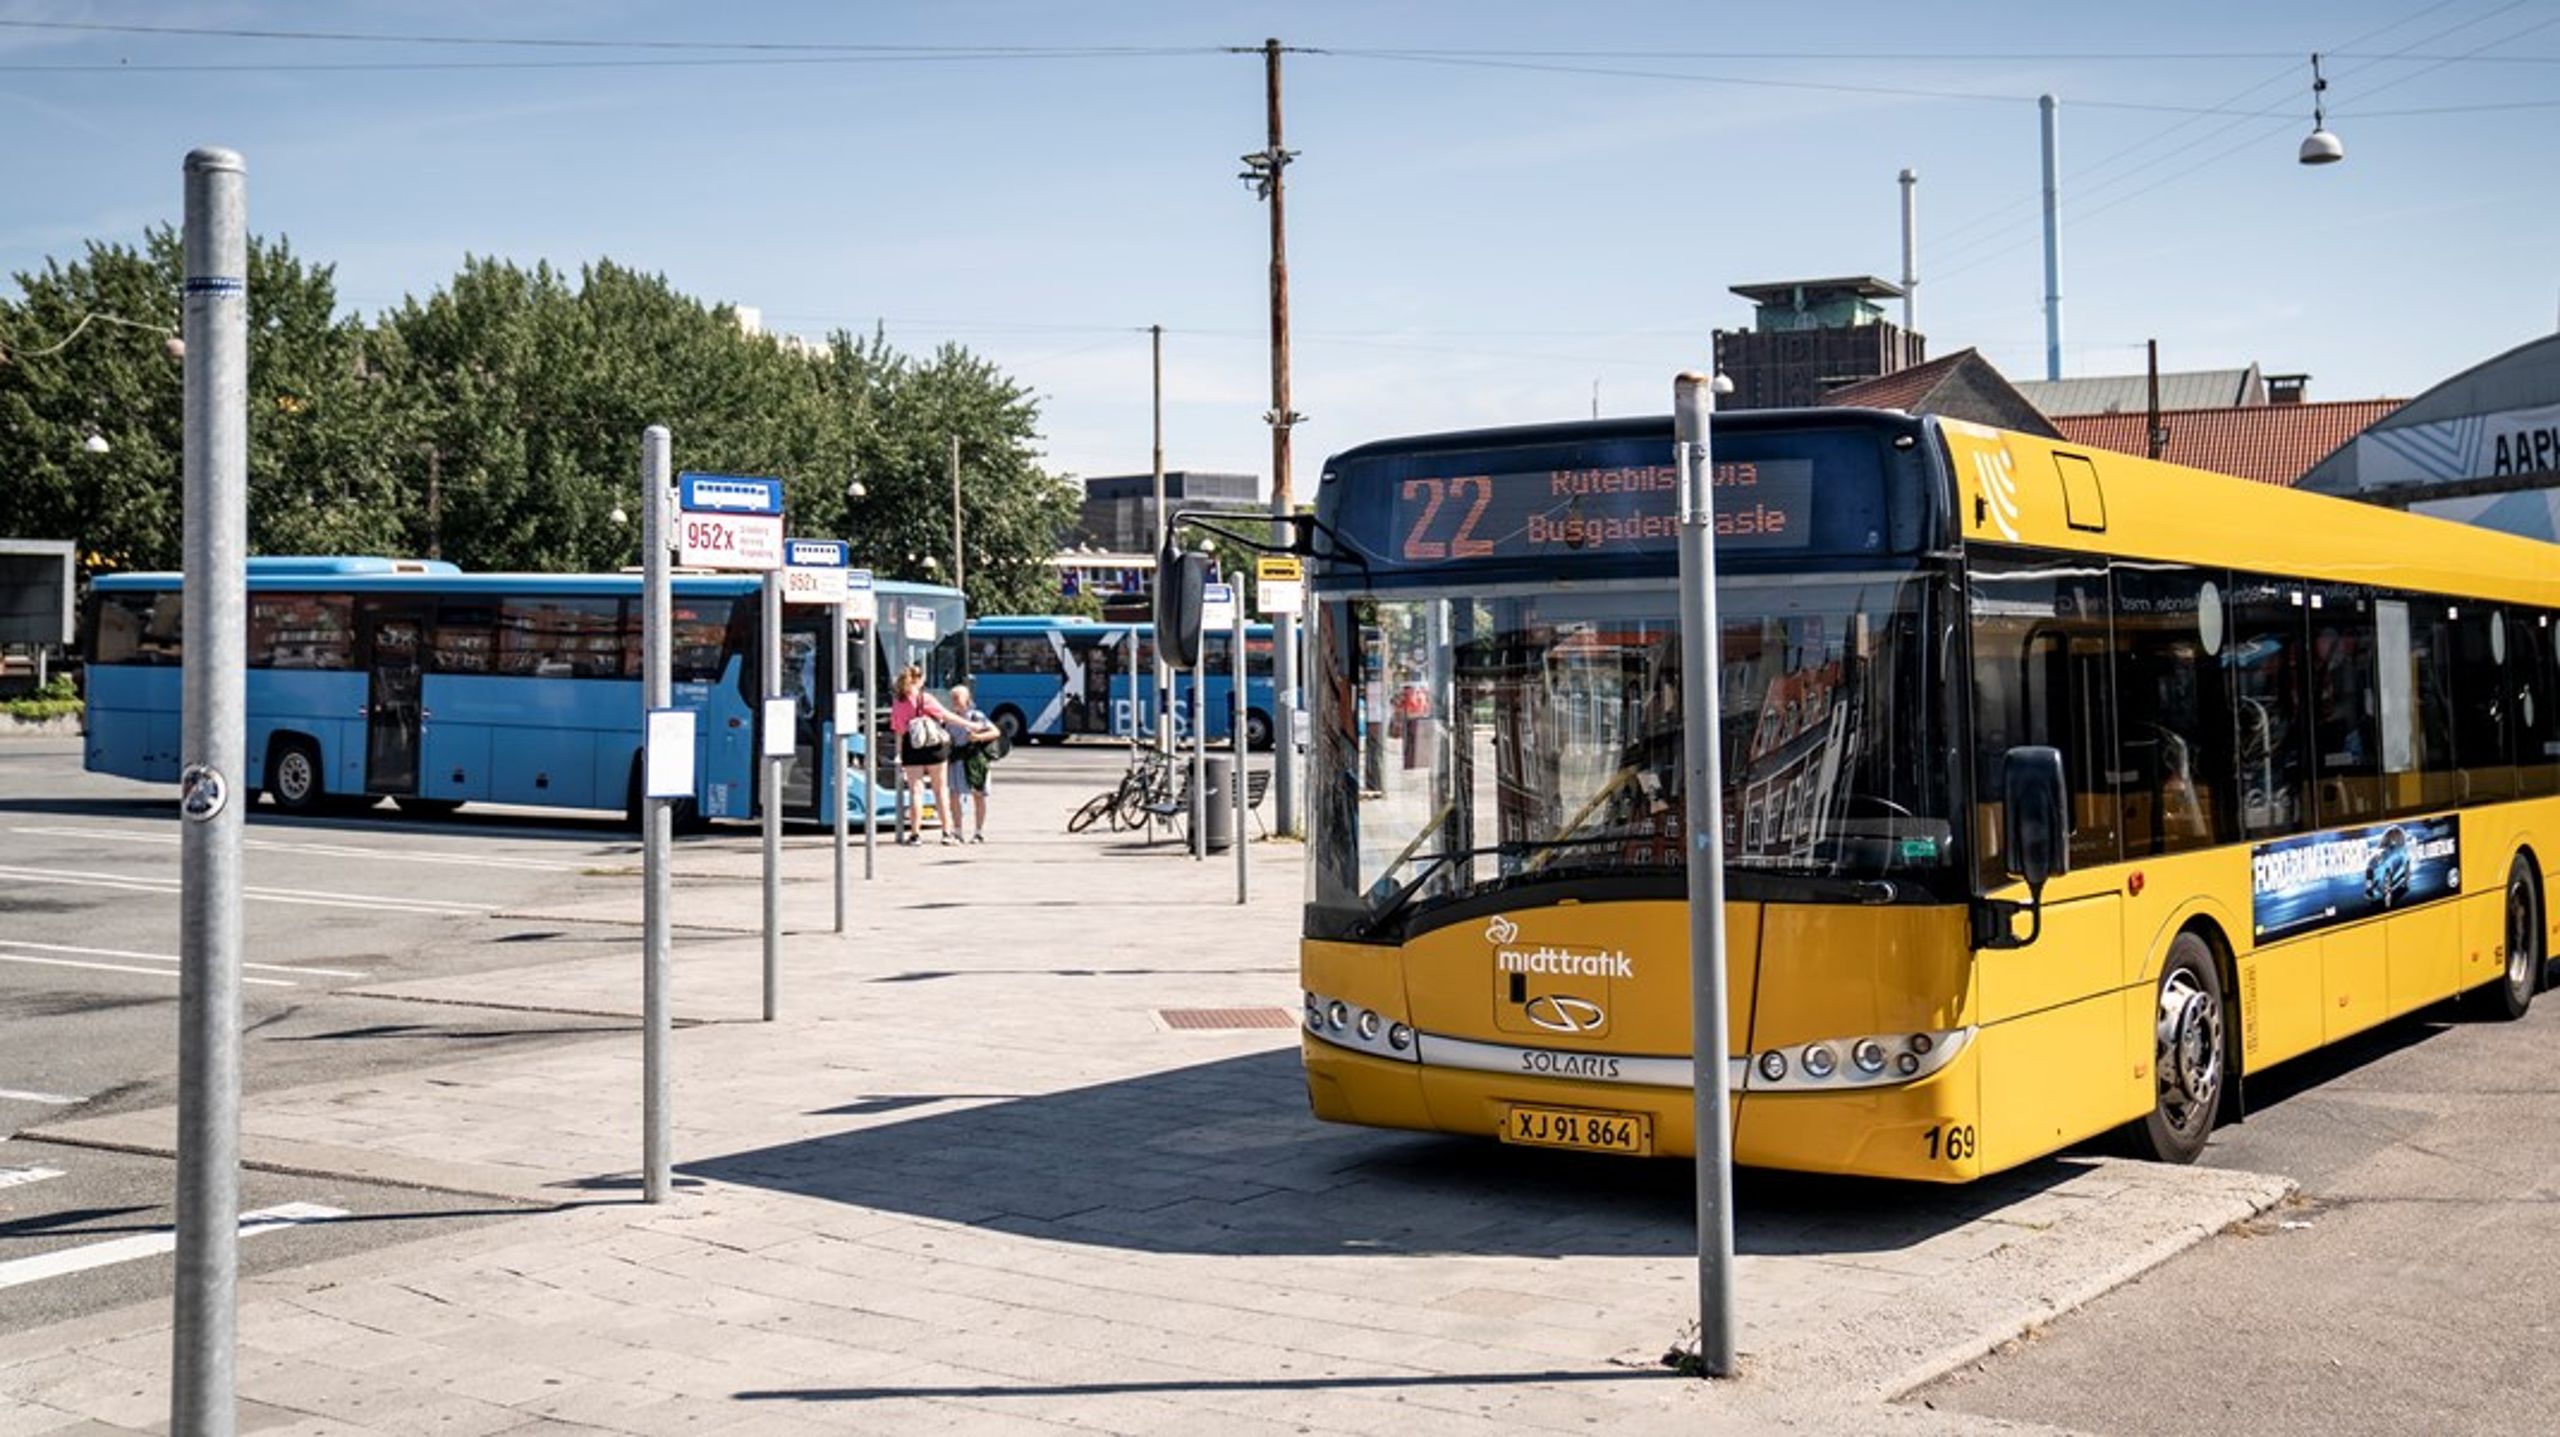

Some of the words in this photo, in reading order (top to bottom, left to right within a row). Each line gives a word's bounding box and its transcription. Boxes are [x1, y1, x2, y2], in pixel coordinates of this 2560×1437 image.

[1551, 466, 1676, 496] Rutebils
[1403, 476, 1494, 559] 22
[1527, 509, 1682, 548] Busgaden
[1714, 502, 1787, 536] asle
[688, 522, 735, 551] 952x
[1499, 946, 1634, 979] midttrafik
[1522, 1051, 1620, 1078] SOLARIS
[1520, 1113, 1548, 1139] XJ
[1555, 1116, 1580, 1142] 91
[1588, 1119, 1630, 1147] 864
[1923, 1124, 1976, 1161] 169
